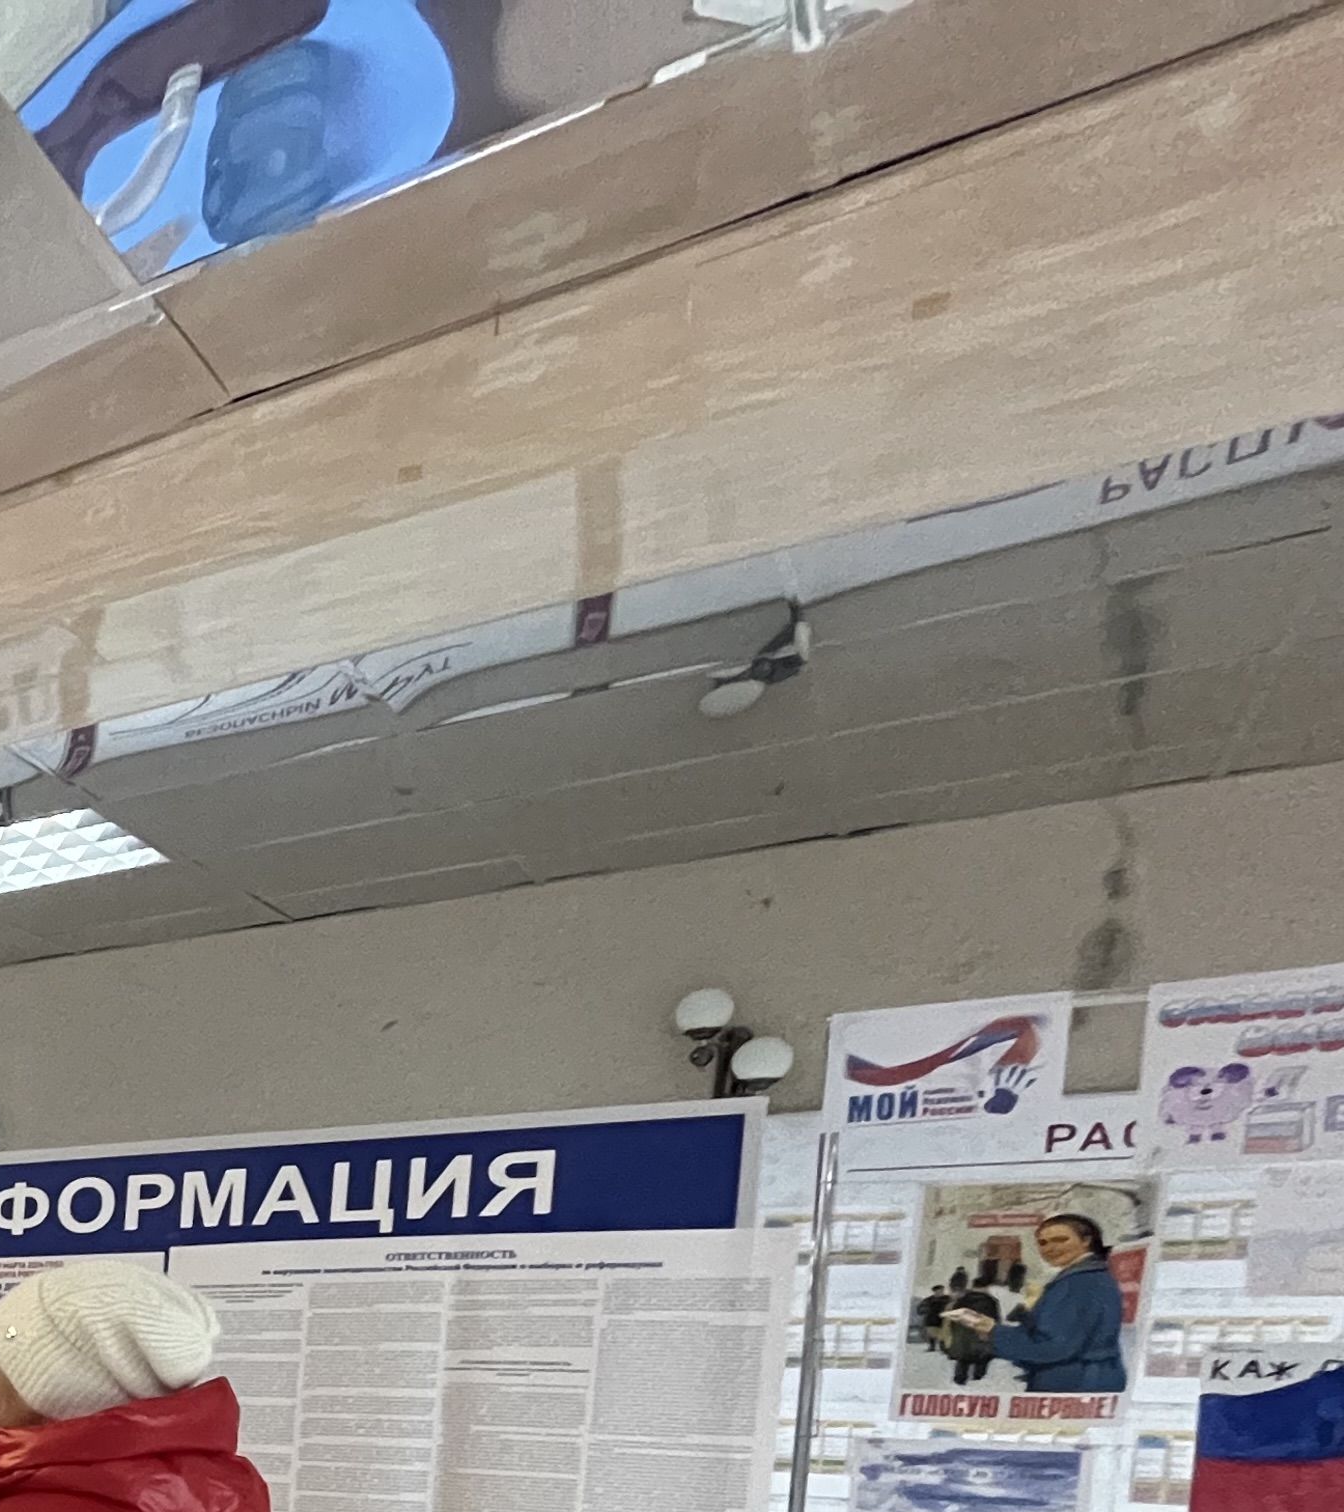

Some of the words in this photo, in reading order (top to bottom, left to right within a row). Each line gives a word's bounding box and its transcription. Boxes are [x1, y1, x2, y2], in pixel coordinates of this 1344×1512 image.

[847, 1085, 918, 1123] МОЙ
[899, 1393, 1000, 1417] ГОЛОСУЮ
[1008, 1395, 1119, 1419] ВПЕРВЫЕ!
